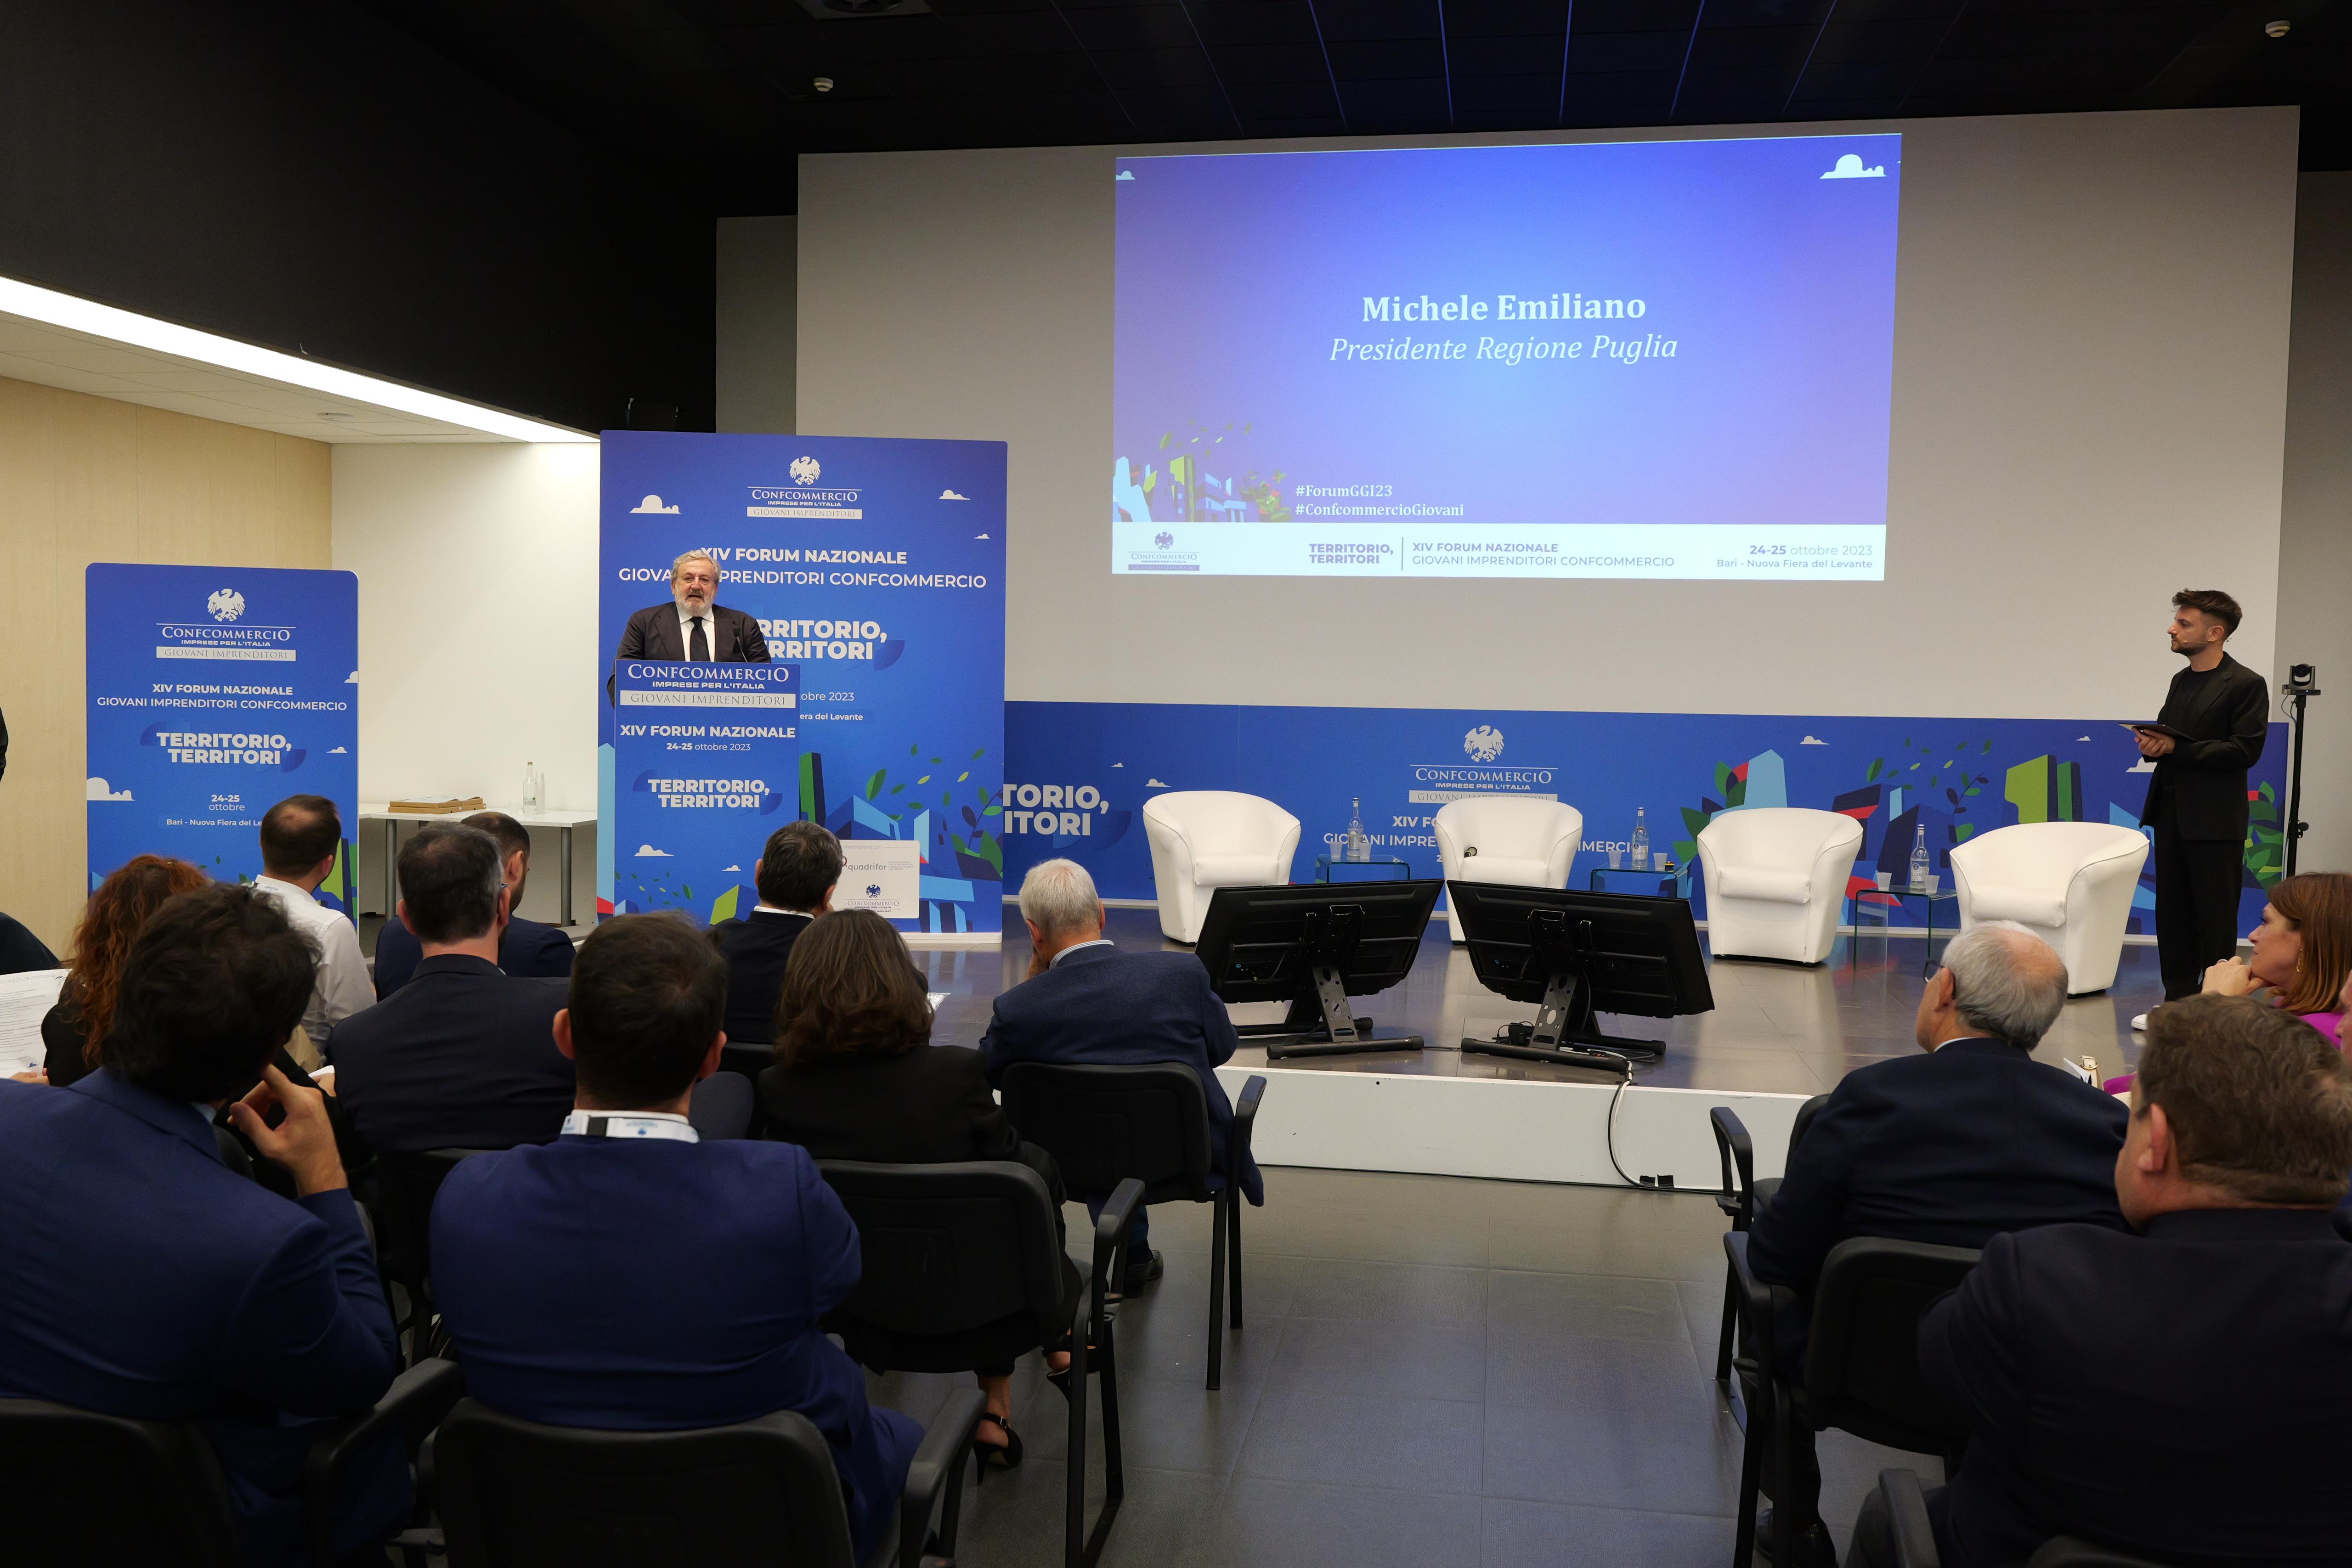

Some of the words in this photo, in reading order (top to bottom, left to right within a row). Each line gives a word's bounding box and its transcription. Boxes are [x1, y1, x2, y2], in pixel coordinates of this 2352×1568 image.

[1363, 295, 1488, 321] Michele
[1497, 293, 1646, 320] Emiliano
[1330, 337, 1466, 361] Presidente
[1476, 336, 1582, 366] Regione
[1591, 333, 1678, 364] Puglia
[752, 489, 858, 502] CONFCOMMERCIO
[1295, 485, 1392, 497] #ForumGGI23
[793, 509, 856, 518] IMPRENDITORI
[1295, 504, 1464, 517] #ConfcommercioGiovani
[1309, 543, 1393, 555] TERRITORIO,
[1413, 542, 1433, 551] XIV
[1437, 542, 1481, 552] FORUM
[1487, 543, 1558, 553] NAZIONALE
[1750, 545, 1787, 554] 24-25
[1791, 545, 1838, 555] ottobre
[1843, 545, 1872, 555] 2023
[701, 548, 731, 561] XIV
[735, 548, 799, 563] FORUM
[804, 550, 907, 564] NAZIONALE
[1309, 554, 1380, 564] TERRITORI
[1413, 555, 1463, 565] GIOVANI
[1467, 556, 1556, 566] IMPRENDITORI
[1560, 556, 1674, 566] CONFCOMMERCIO
[1717, 559, 1737, 568] Bari
[1747, 559, 1780, 568] Nuova
[1783, 559, 1809, 568] Fiera
[1811, 559, 1827, 569] del
[1831, 559, 1872, 569] Levante
[619, 568, 672, 581] GIOVA
[720, 570, 824, 585] PRENDITORI
[830, 572, 986, 588] CONFCOMMERCIO
[162, 626, 290, 641] CONFCOMMERCIO
[757, 620, 887, 643] RRITORIO,
[165, 649, 208, 657] GIOVANI
[213, 650, 288, 659] IMPRENDITORI
[768, 640, 873, 660] RRITORI
[628, 664, 789, 682] CONFCOMMERCIO
[153, 683, 172, 693] XIV
[176, 684, 220, 694] FORUM
[224, 685, 293, 695] NAZIONALE
[631, 694, 687, 704] GIOVANI
[692, 695, 785, 705] IMPRENDITORI
[801, 692, 825, 700] obre
[829, 693, 854, 701] 2023
[97, 697, 147, 706] GIOVANI
[151, 698, 237, 708] IMPRENDITORI
[240, 699, 347, 711] CONFCOMMERCIO
[620, 726, 646, 736] XIV
[651, 726, 705, 737] FORUM
[710, 726, 796, 738] NAZIONALE
[157, 733, 292, 751] TERRITORIO,
[168, 749, 280, 764] TERRITORI
[1416, 768, 1551, 784] CONFCOMMERCIO
[648, 779, 769, 795] TERRITORIO,
[211, 794, 240, 802] 24-25
[658, 794, 759, 808] TERRITORI
[1003, 784, 1108, 814] TORIO,
[1418, 793, 1463, 801] GIOVANI
[209, 803, 245, 811] ottobre
[1005, 811, 1091, 836] ITORI
[1393, 816, 1417, 827] XIV
[1324, 833, 1385, 846] GIOANI
